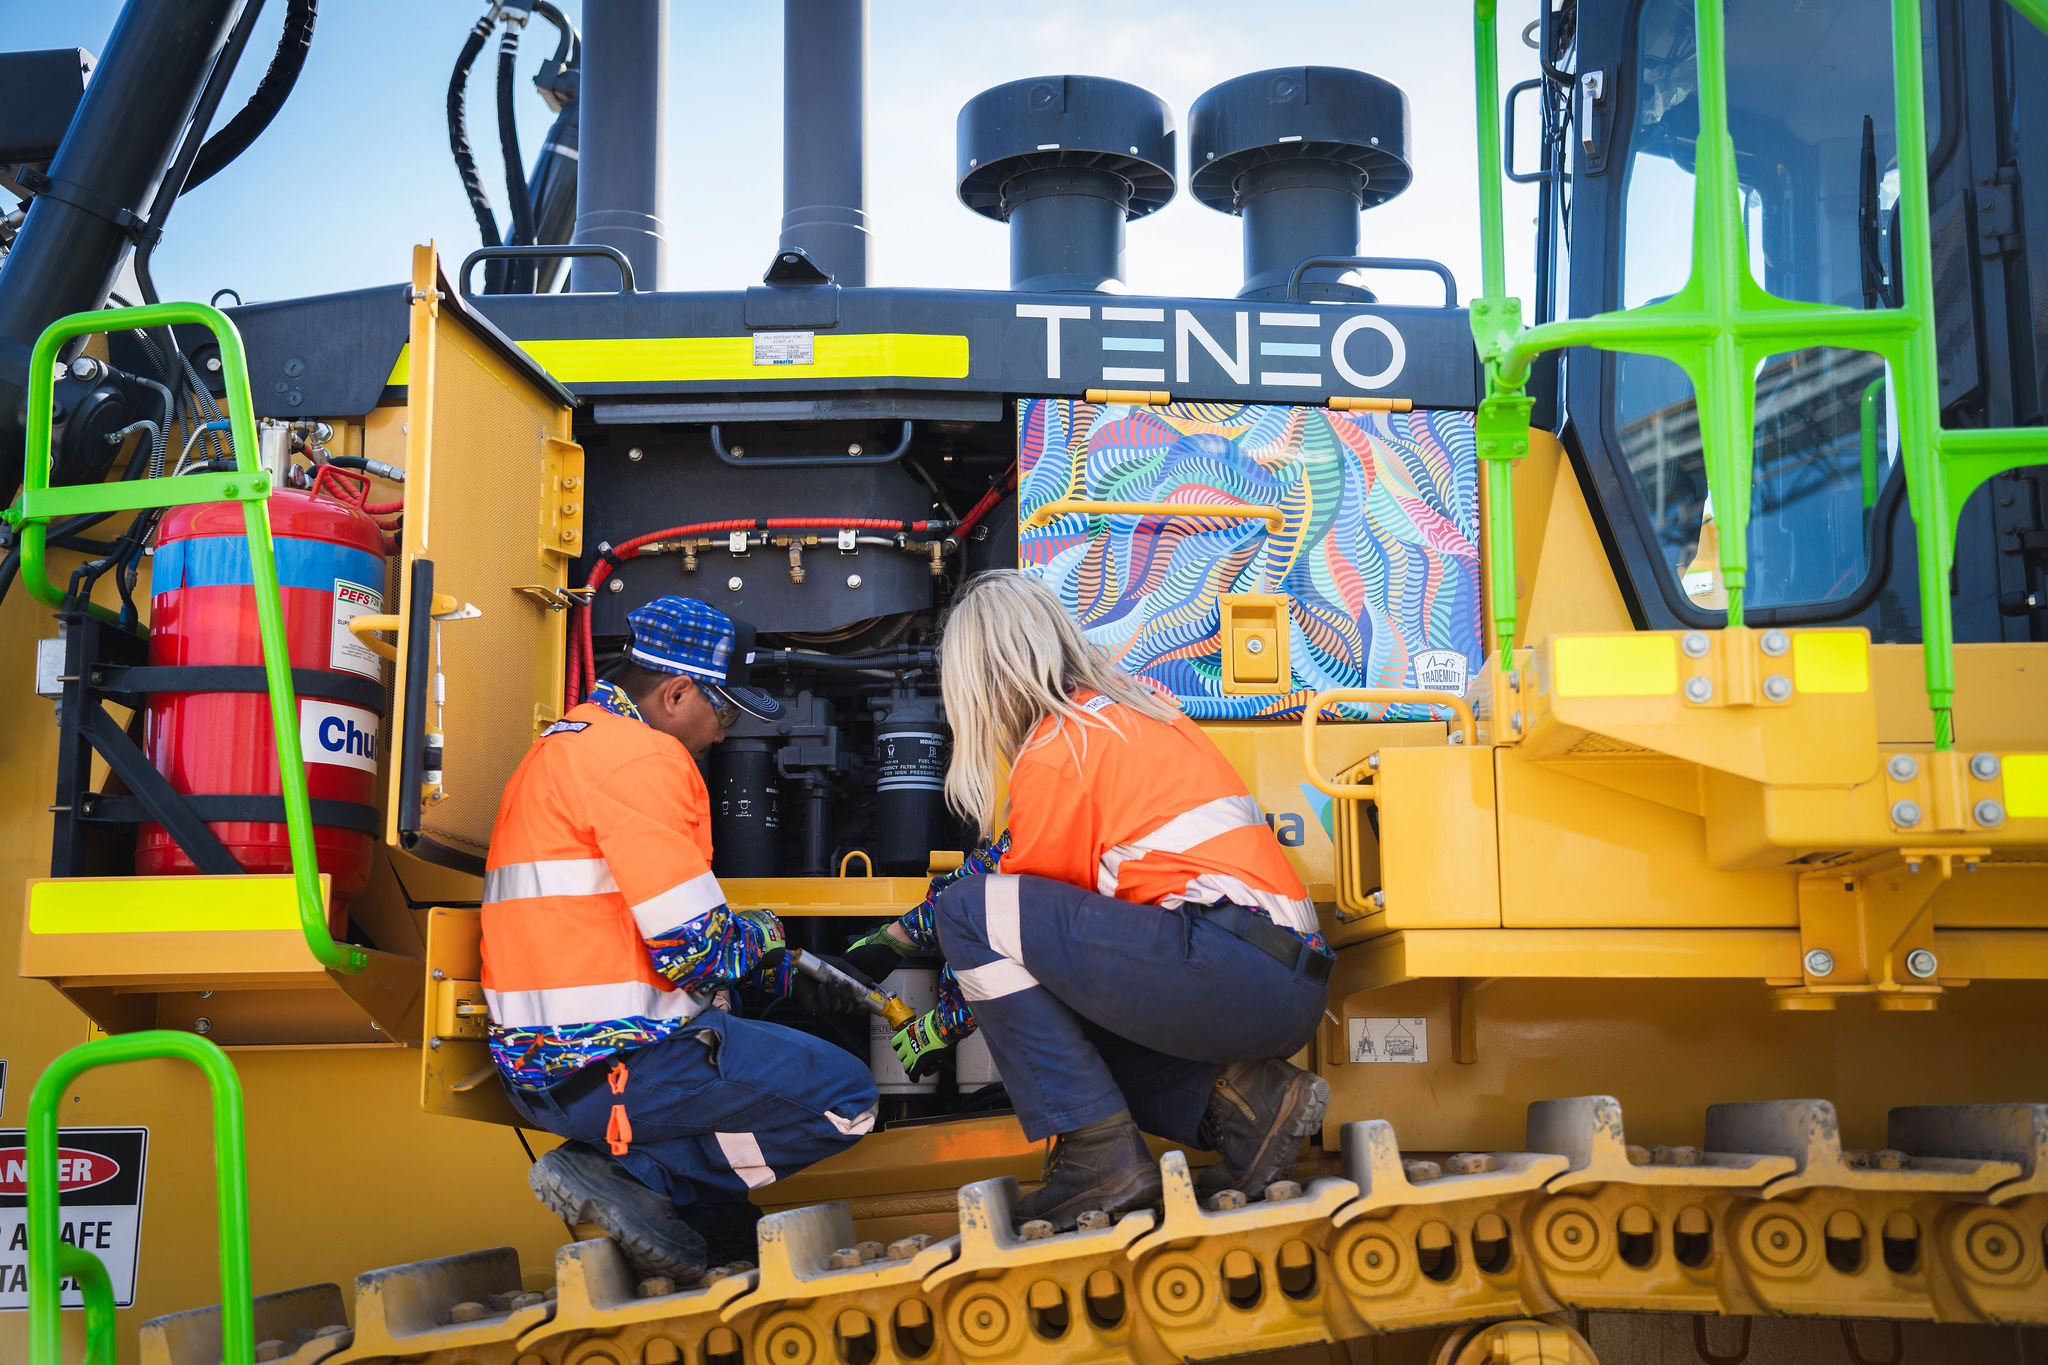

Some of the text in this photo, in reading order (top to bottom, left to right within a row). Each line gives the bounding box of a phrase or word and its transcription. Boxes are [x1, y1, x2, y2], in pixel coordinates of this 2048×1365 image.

[1016, 304, 1406, 389] TENEO
[339, 588, 370, 605] PEFS
[1422, 669, 1461, 682] TRADEMUTT
[60, 1221, 113, 1249] AFE
